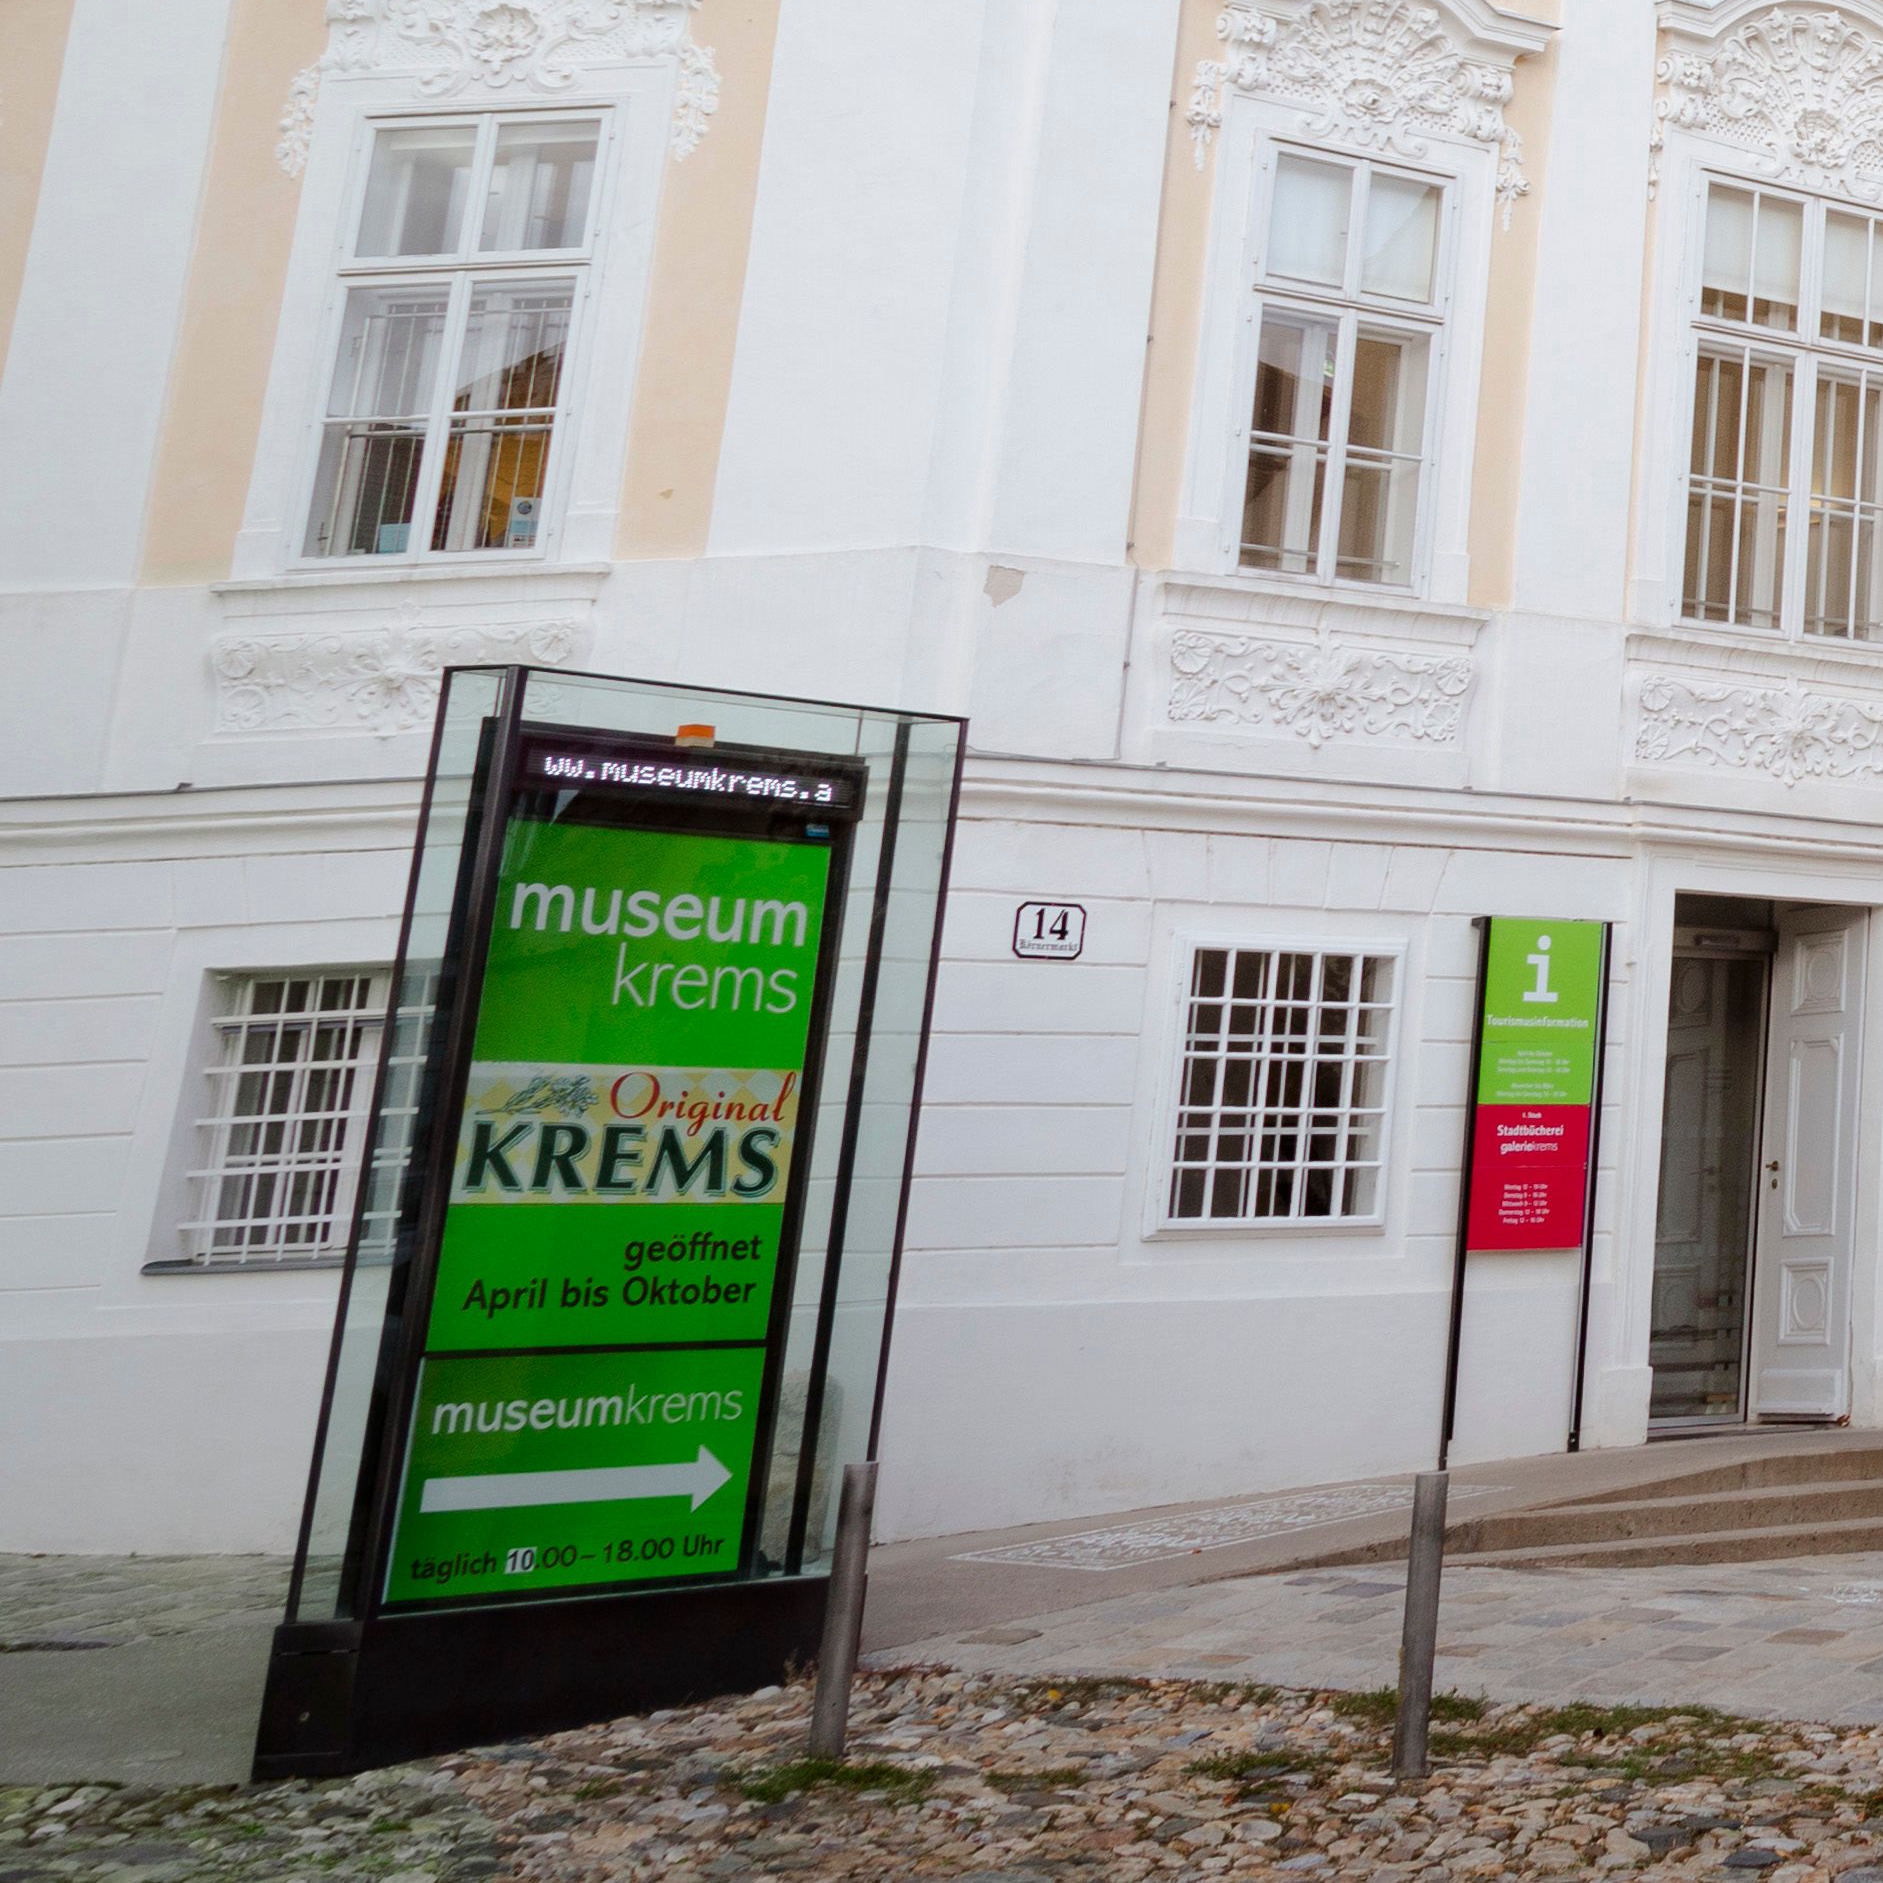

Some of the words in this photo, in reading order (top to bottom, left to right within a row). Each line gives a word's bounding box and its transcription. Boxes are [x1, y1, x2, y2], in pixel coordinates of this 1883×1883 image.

[510, 882, 809, 948] museum
[1033, 908, 1070, 940] 14
[612, 941, 798, 1015] krems
[1486, 1014, 1590, 1029] Tourismusinformation
[609, 1070, 797, 1137] Original
[1496, 1124, 1565, 1137] Stadtbücherei
[462, 1120, 782, 1199] KREMS
[624, 1231, 762, 1272] geöffnet
[462, 1278, 548, 1319] April
[560, 1278, 609, 1309] bis
[622, 1274, 757, 1307] Oktober
[432, 1384, 743, 1435] museumkrems
[411, 1551, 497, 1585] täglich
[682, 1534, 726, 1558] Uhr
